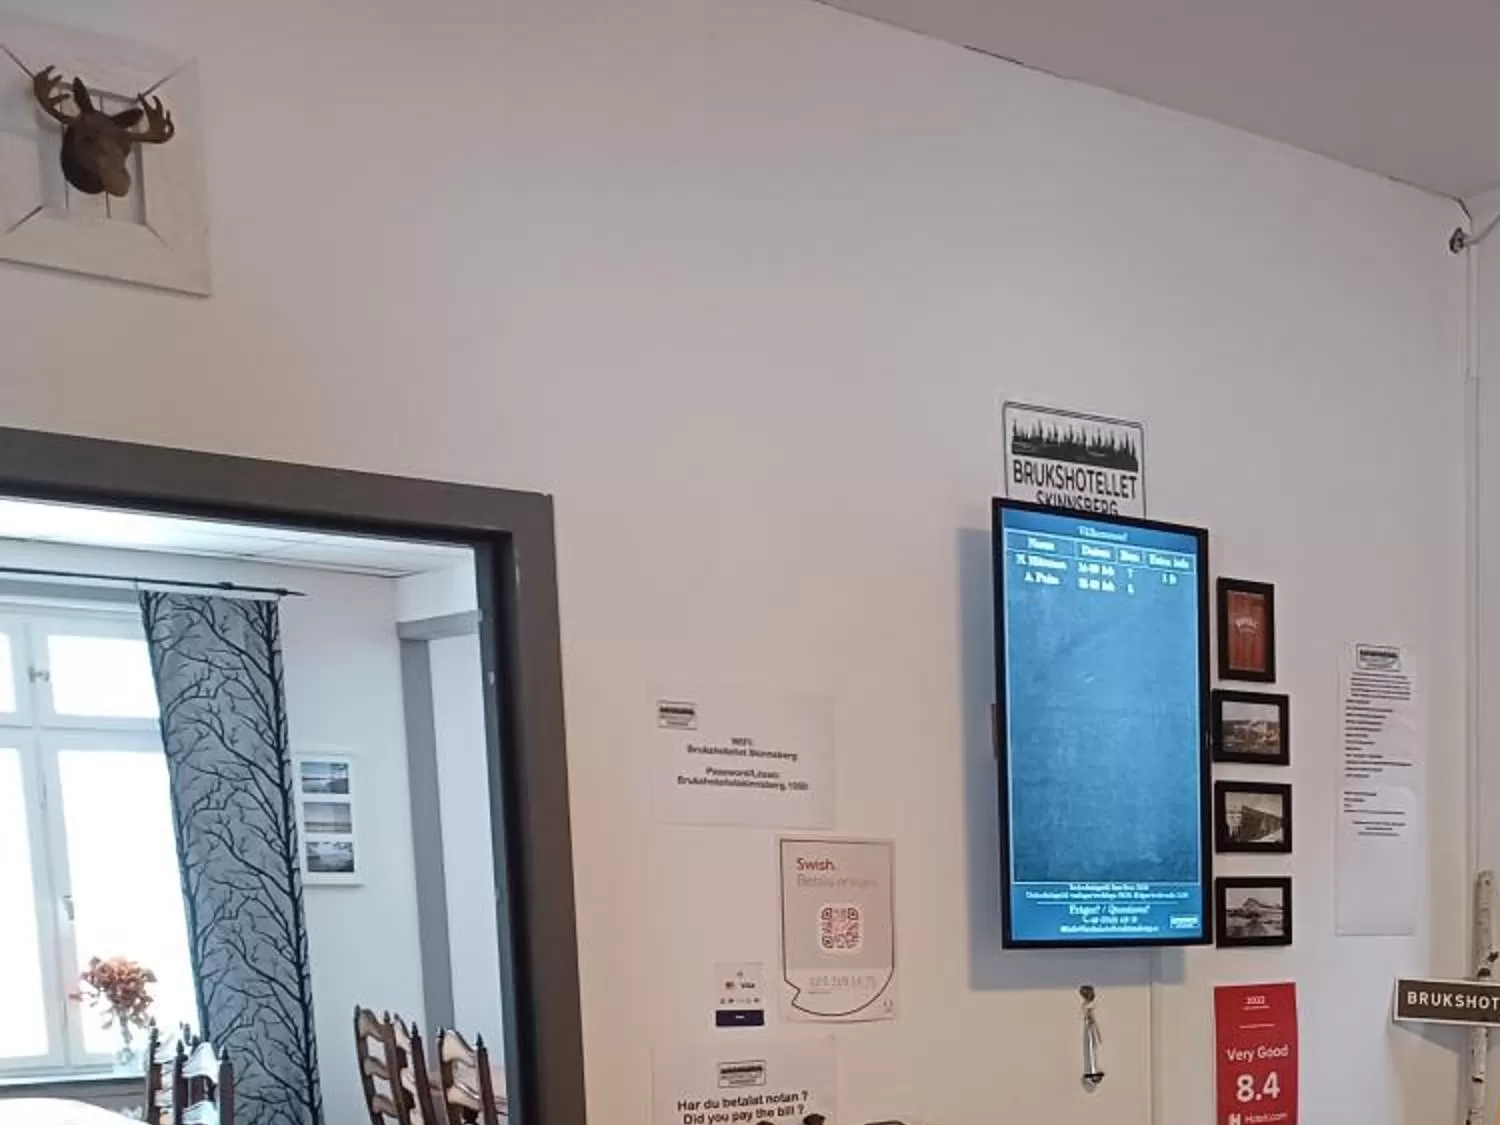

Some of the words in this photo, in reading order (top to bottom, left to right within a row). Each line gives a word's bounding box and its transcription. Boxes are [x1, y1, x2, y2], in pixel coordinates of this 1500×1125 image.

[1012, 459, 1137, 500] BRUKSHOTELLET
[1226, 1047, 1254, 1063] Very
[1257, 1044, 1289, 1059] Good
[1236, 1071, 1281, 1103] 8.4
[677, 1100, 701, 1112] Har
[703, 1098, 719, 1109] du
[722, 1094, 764, 1108] betalat
[801, 1090, 809, 1101] ?
[683, 1114, 705, 1125] Did
[707, 1112, 730, 1125] you
[731, 1111, 754, 1124] pay
[755, 1107, 775, 1119] the
[777, 1105, 795, 1117] bill
[797, 1103, 805, 1114] ?
